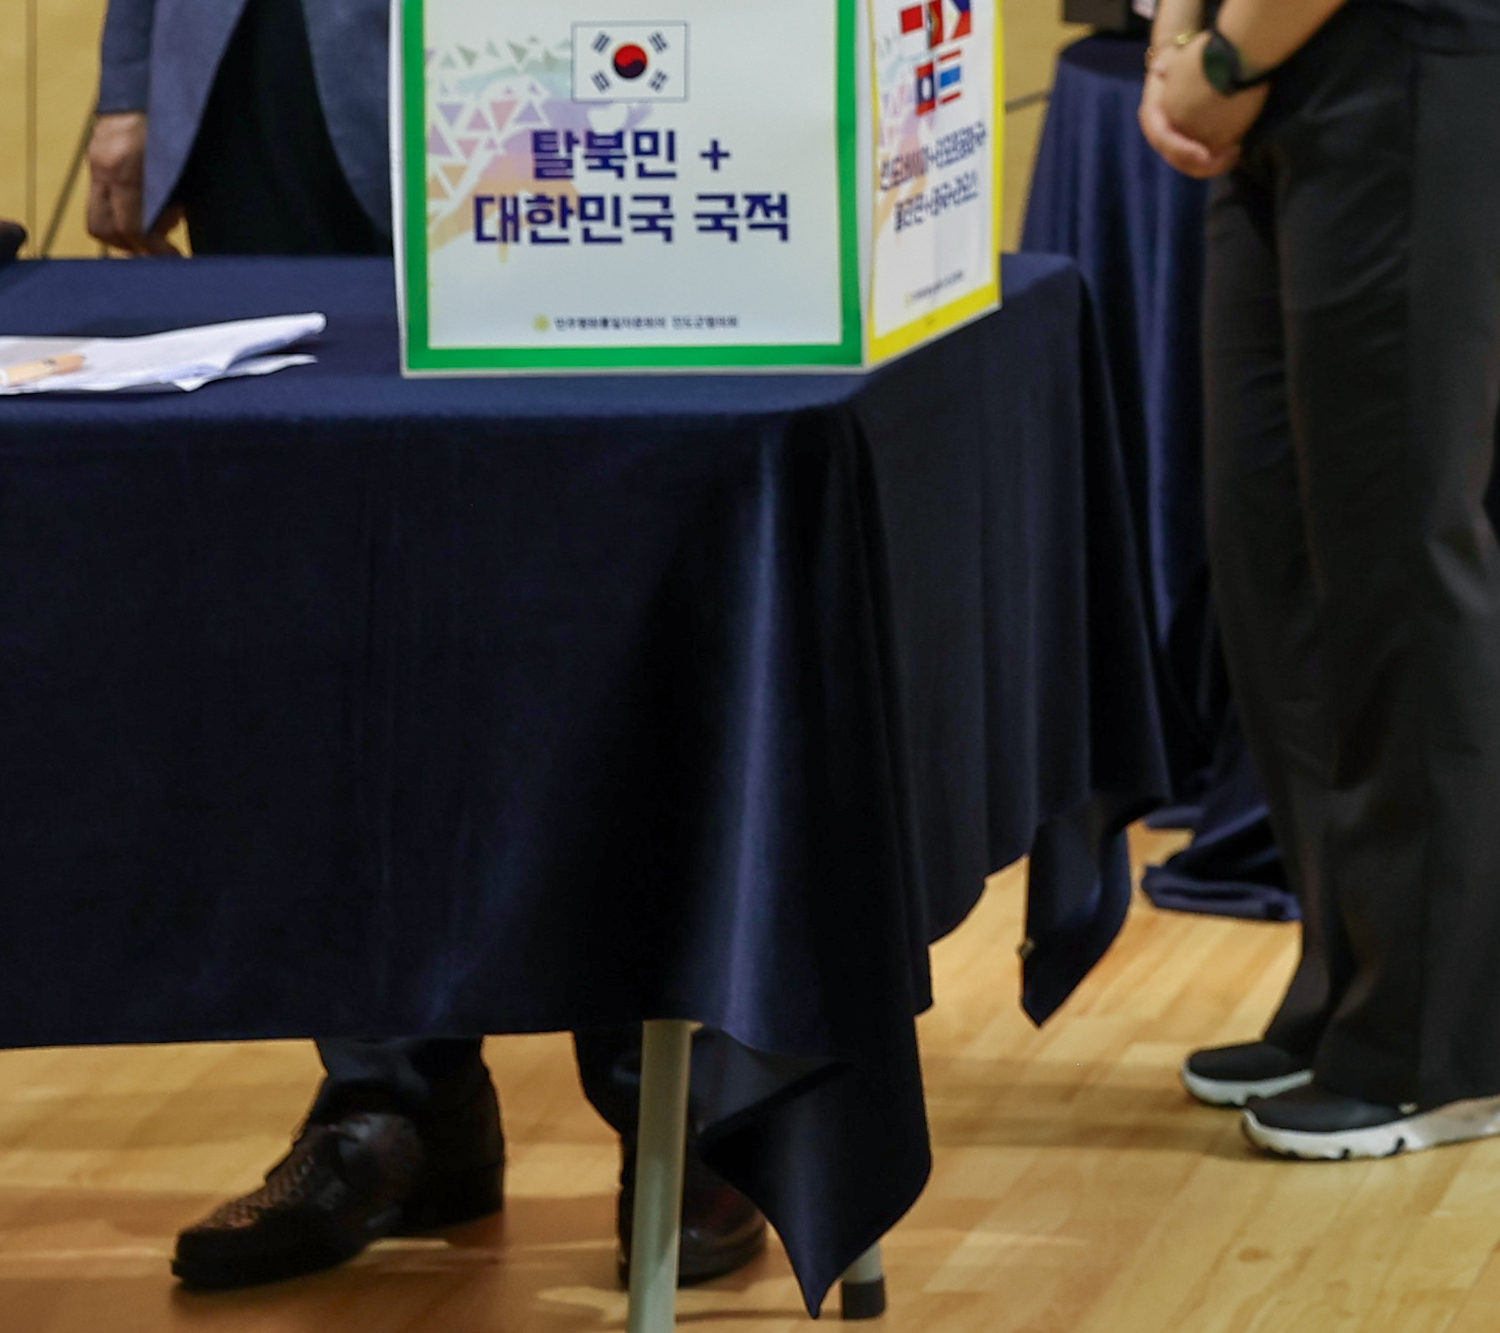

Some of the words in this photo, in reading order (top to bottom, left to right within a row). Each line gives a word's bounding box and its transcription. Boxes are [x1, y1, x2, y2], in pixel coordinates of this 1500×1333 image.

[531, 129, 678, 181] 탈북민
[473, 192, 675, 245] 대한민국
[692, 190, 791, 243] 국적
